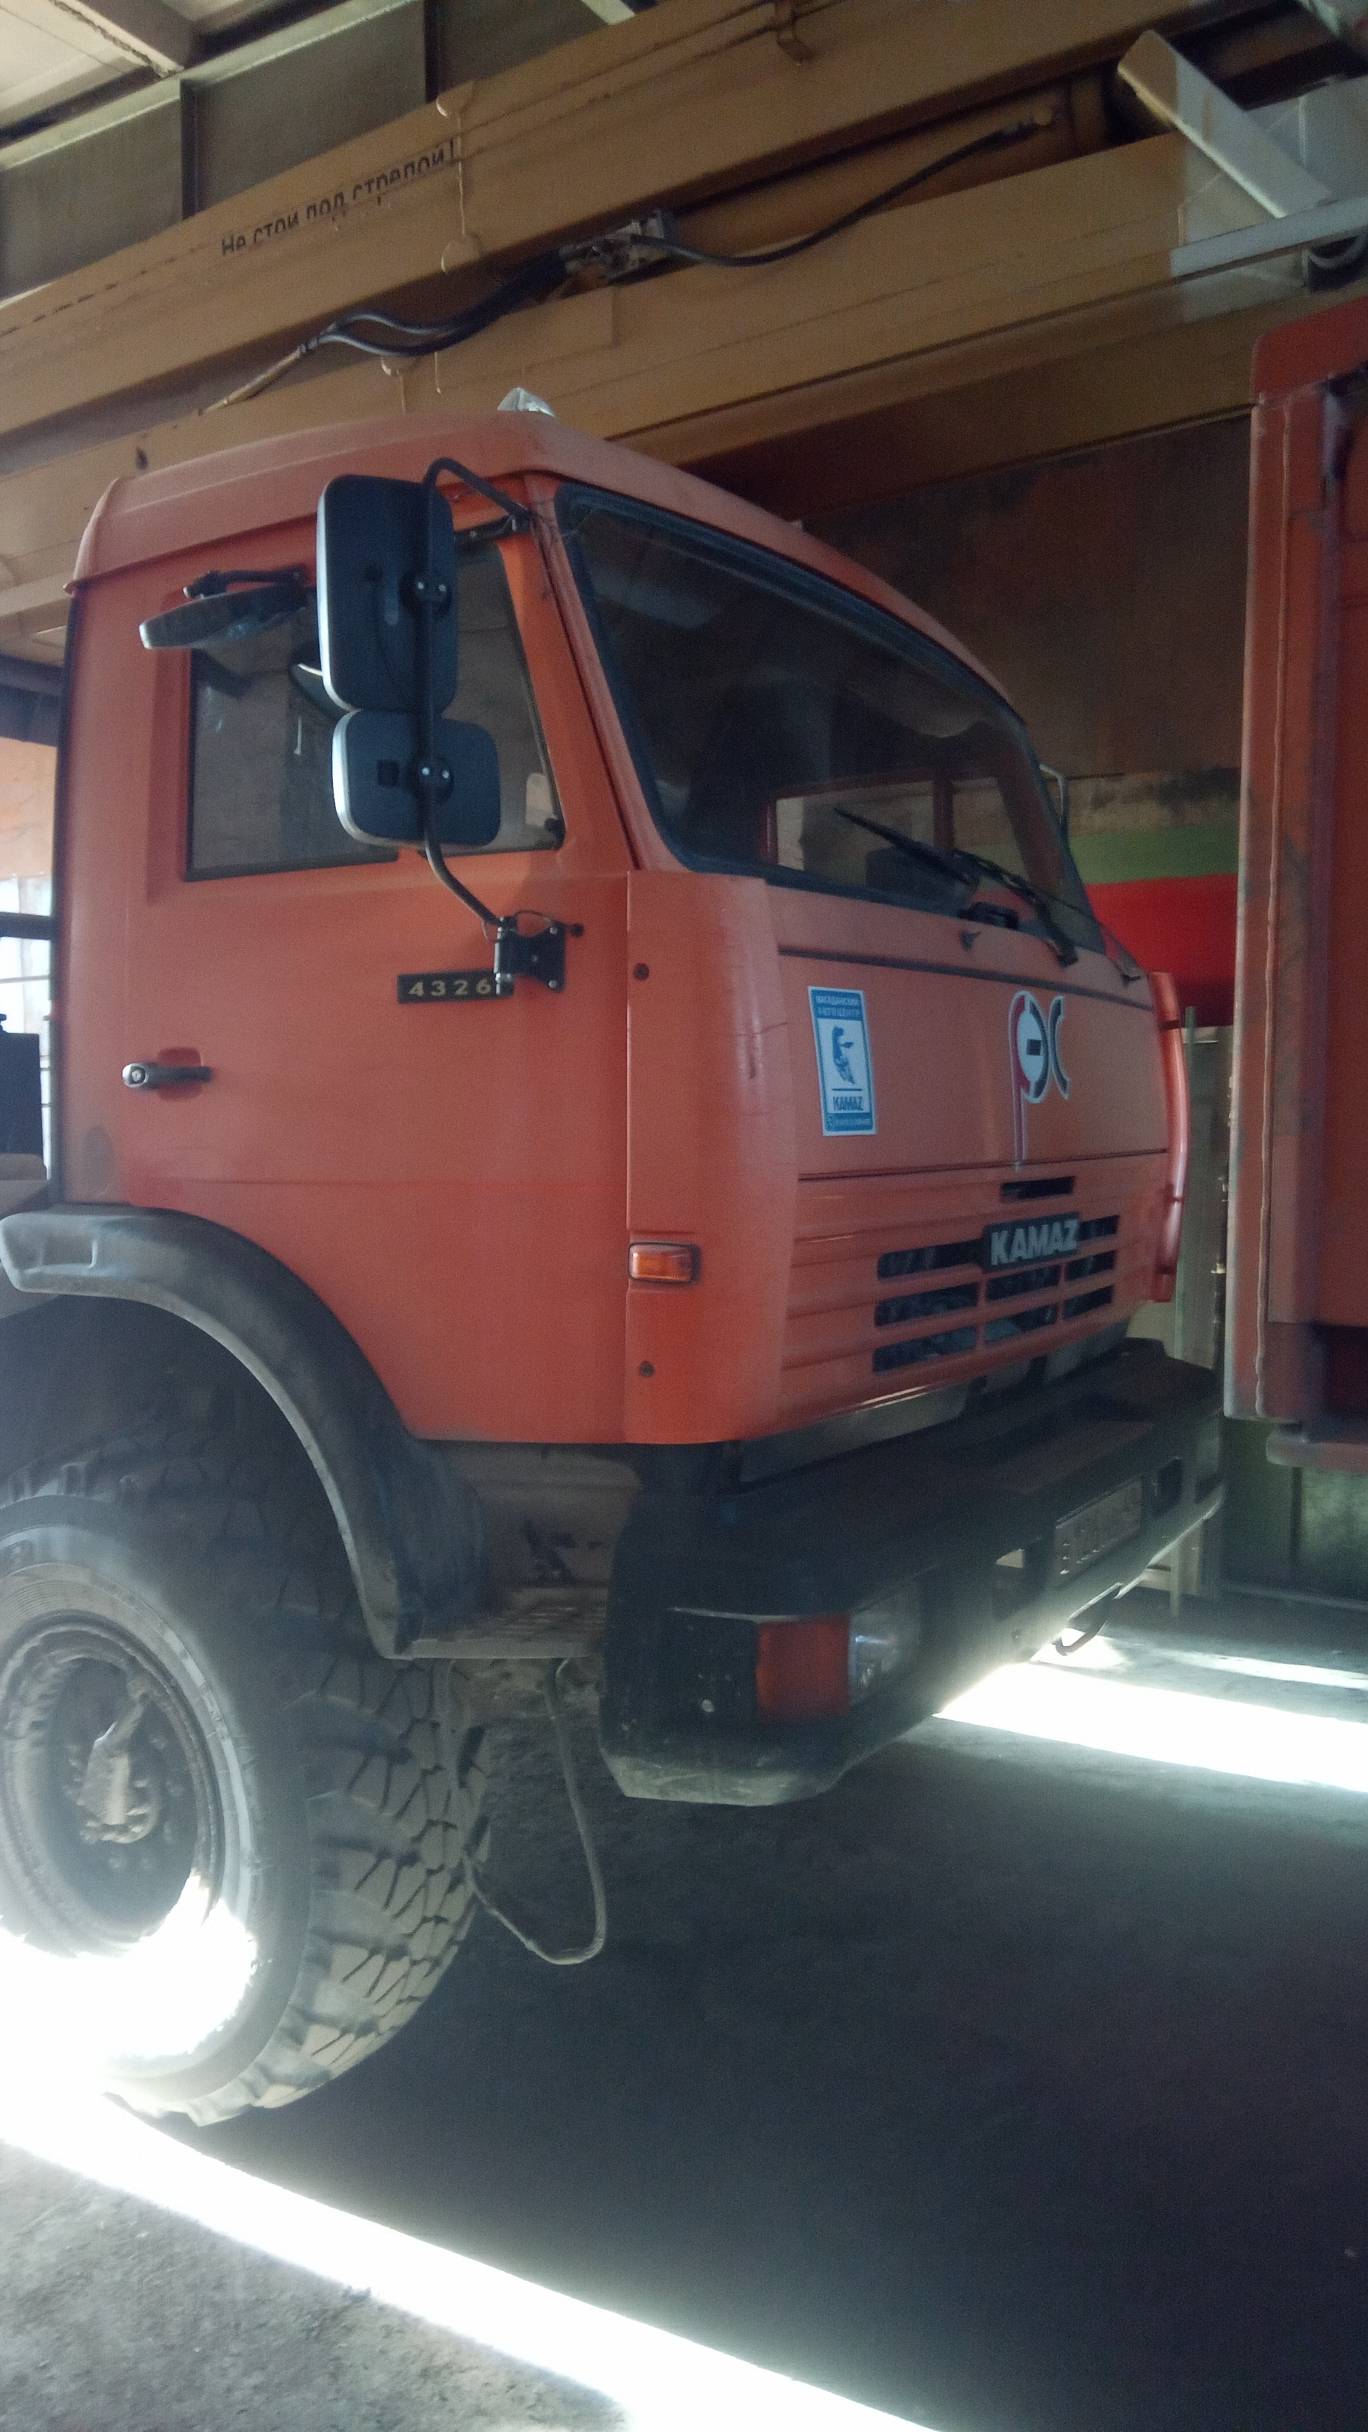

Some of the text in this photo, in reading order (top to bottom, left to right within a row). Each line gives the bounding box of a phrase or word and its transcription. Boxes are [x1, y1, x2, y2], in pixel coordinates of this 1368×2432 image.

[221, 234, 247, 256] Не
[408, 978, 492, 998] 4326
[832, 1096, 864, 1111] KAMAZ
[991, 1219, 1078, 1266] KAMAZ
